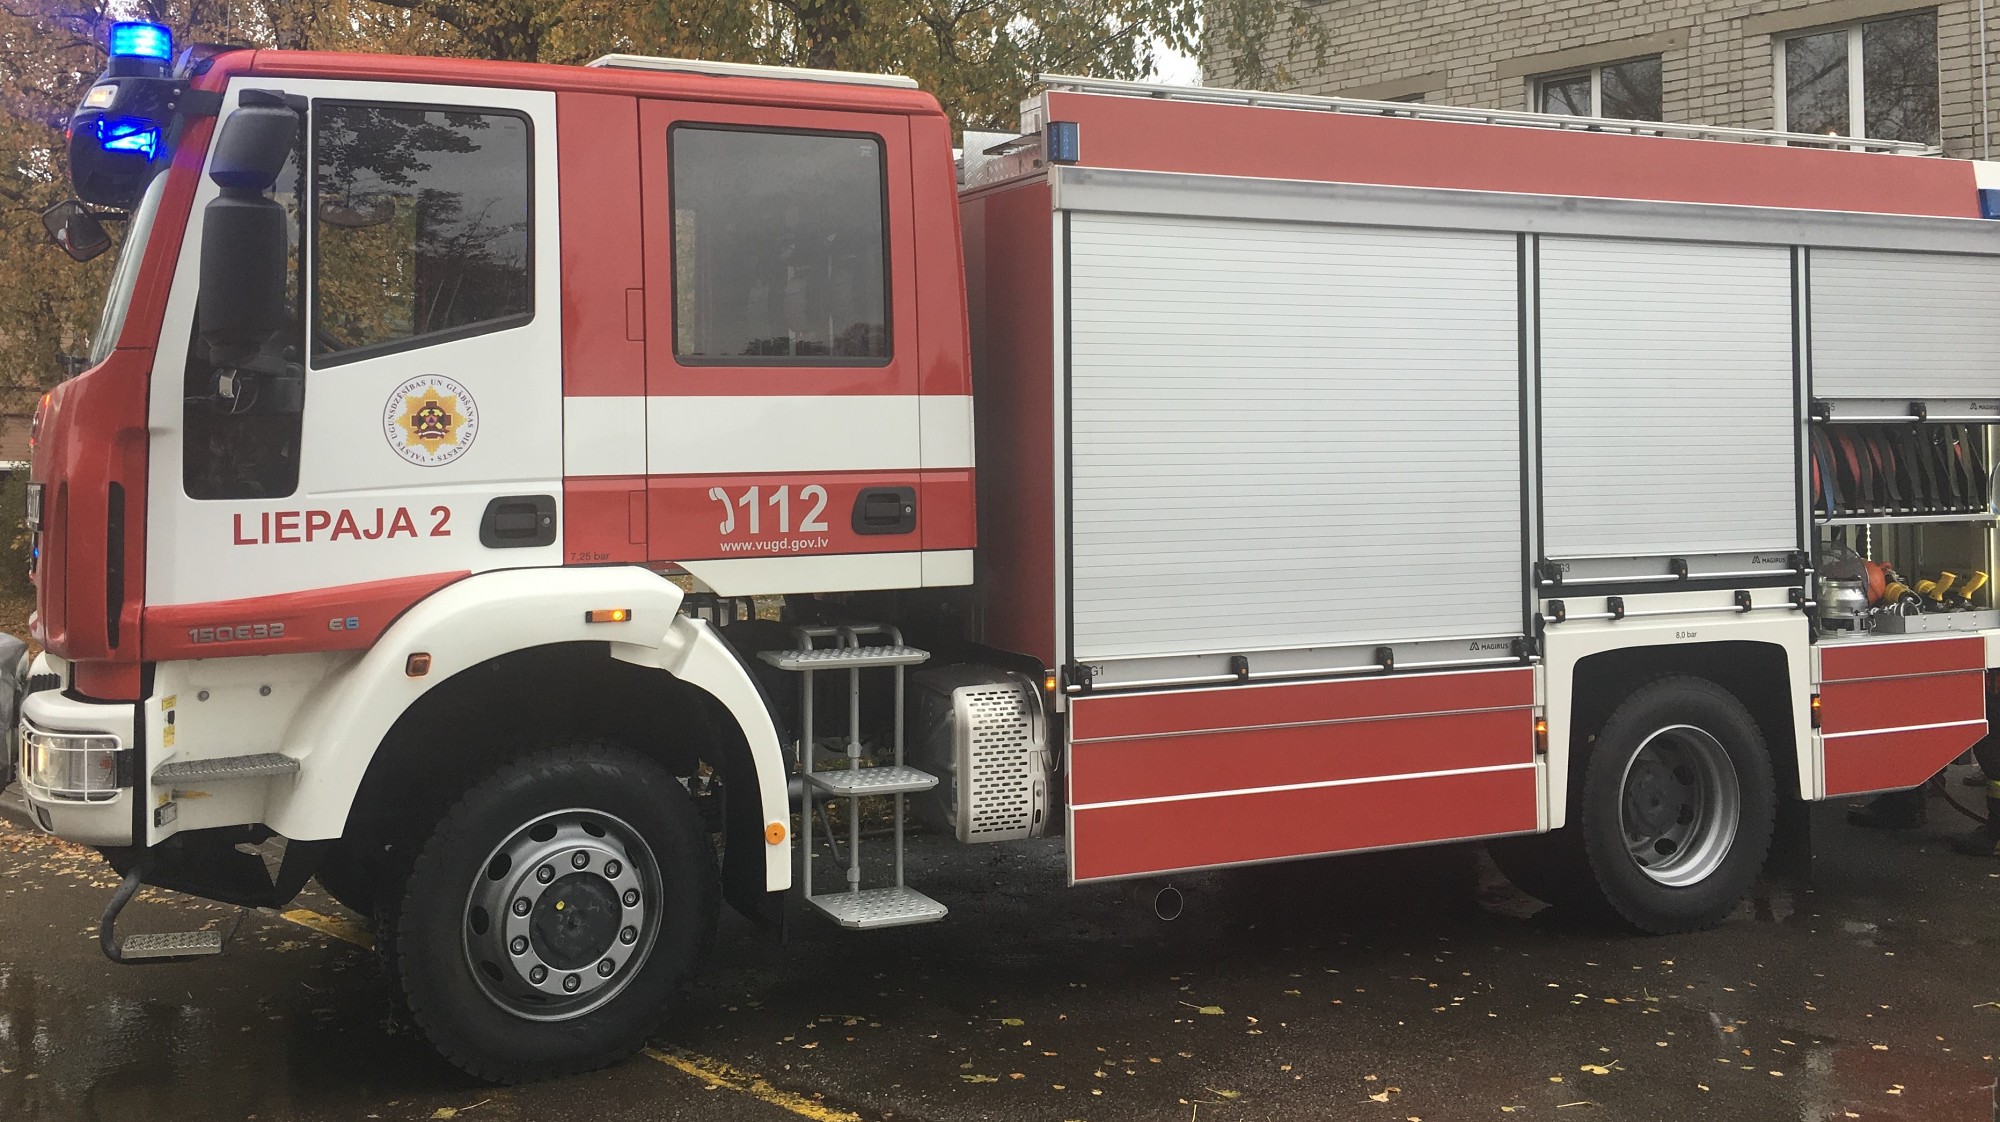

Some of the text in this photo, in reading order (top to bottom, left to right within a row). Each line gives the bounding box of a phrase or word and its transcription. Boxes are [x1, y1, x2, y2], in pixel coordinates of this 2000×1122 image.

[395, 441, 426, 463] VALSTS
[437, 431, 472, 462] DIENESTS
[738, 484, 829, 534] 112
[233, 505, 451, 546] LIEPAJA 2
[720, 536, 829, 553] www.vugd.gov.lv
[570, 551, 609, 562] 7,25 bar
[328, 616, 360, 631] E6
[188, 622, 285, 644] 150E32
[1675, 631, 1697, 639] 8,0 bar
[1480, 642, 1509, 650] MAGIRUS
[1090, 665, 1104, 676] G1
